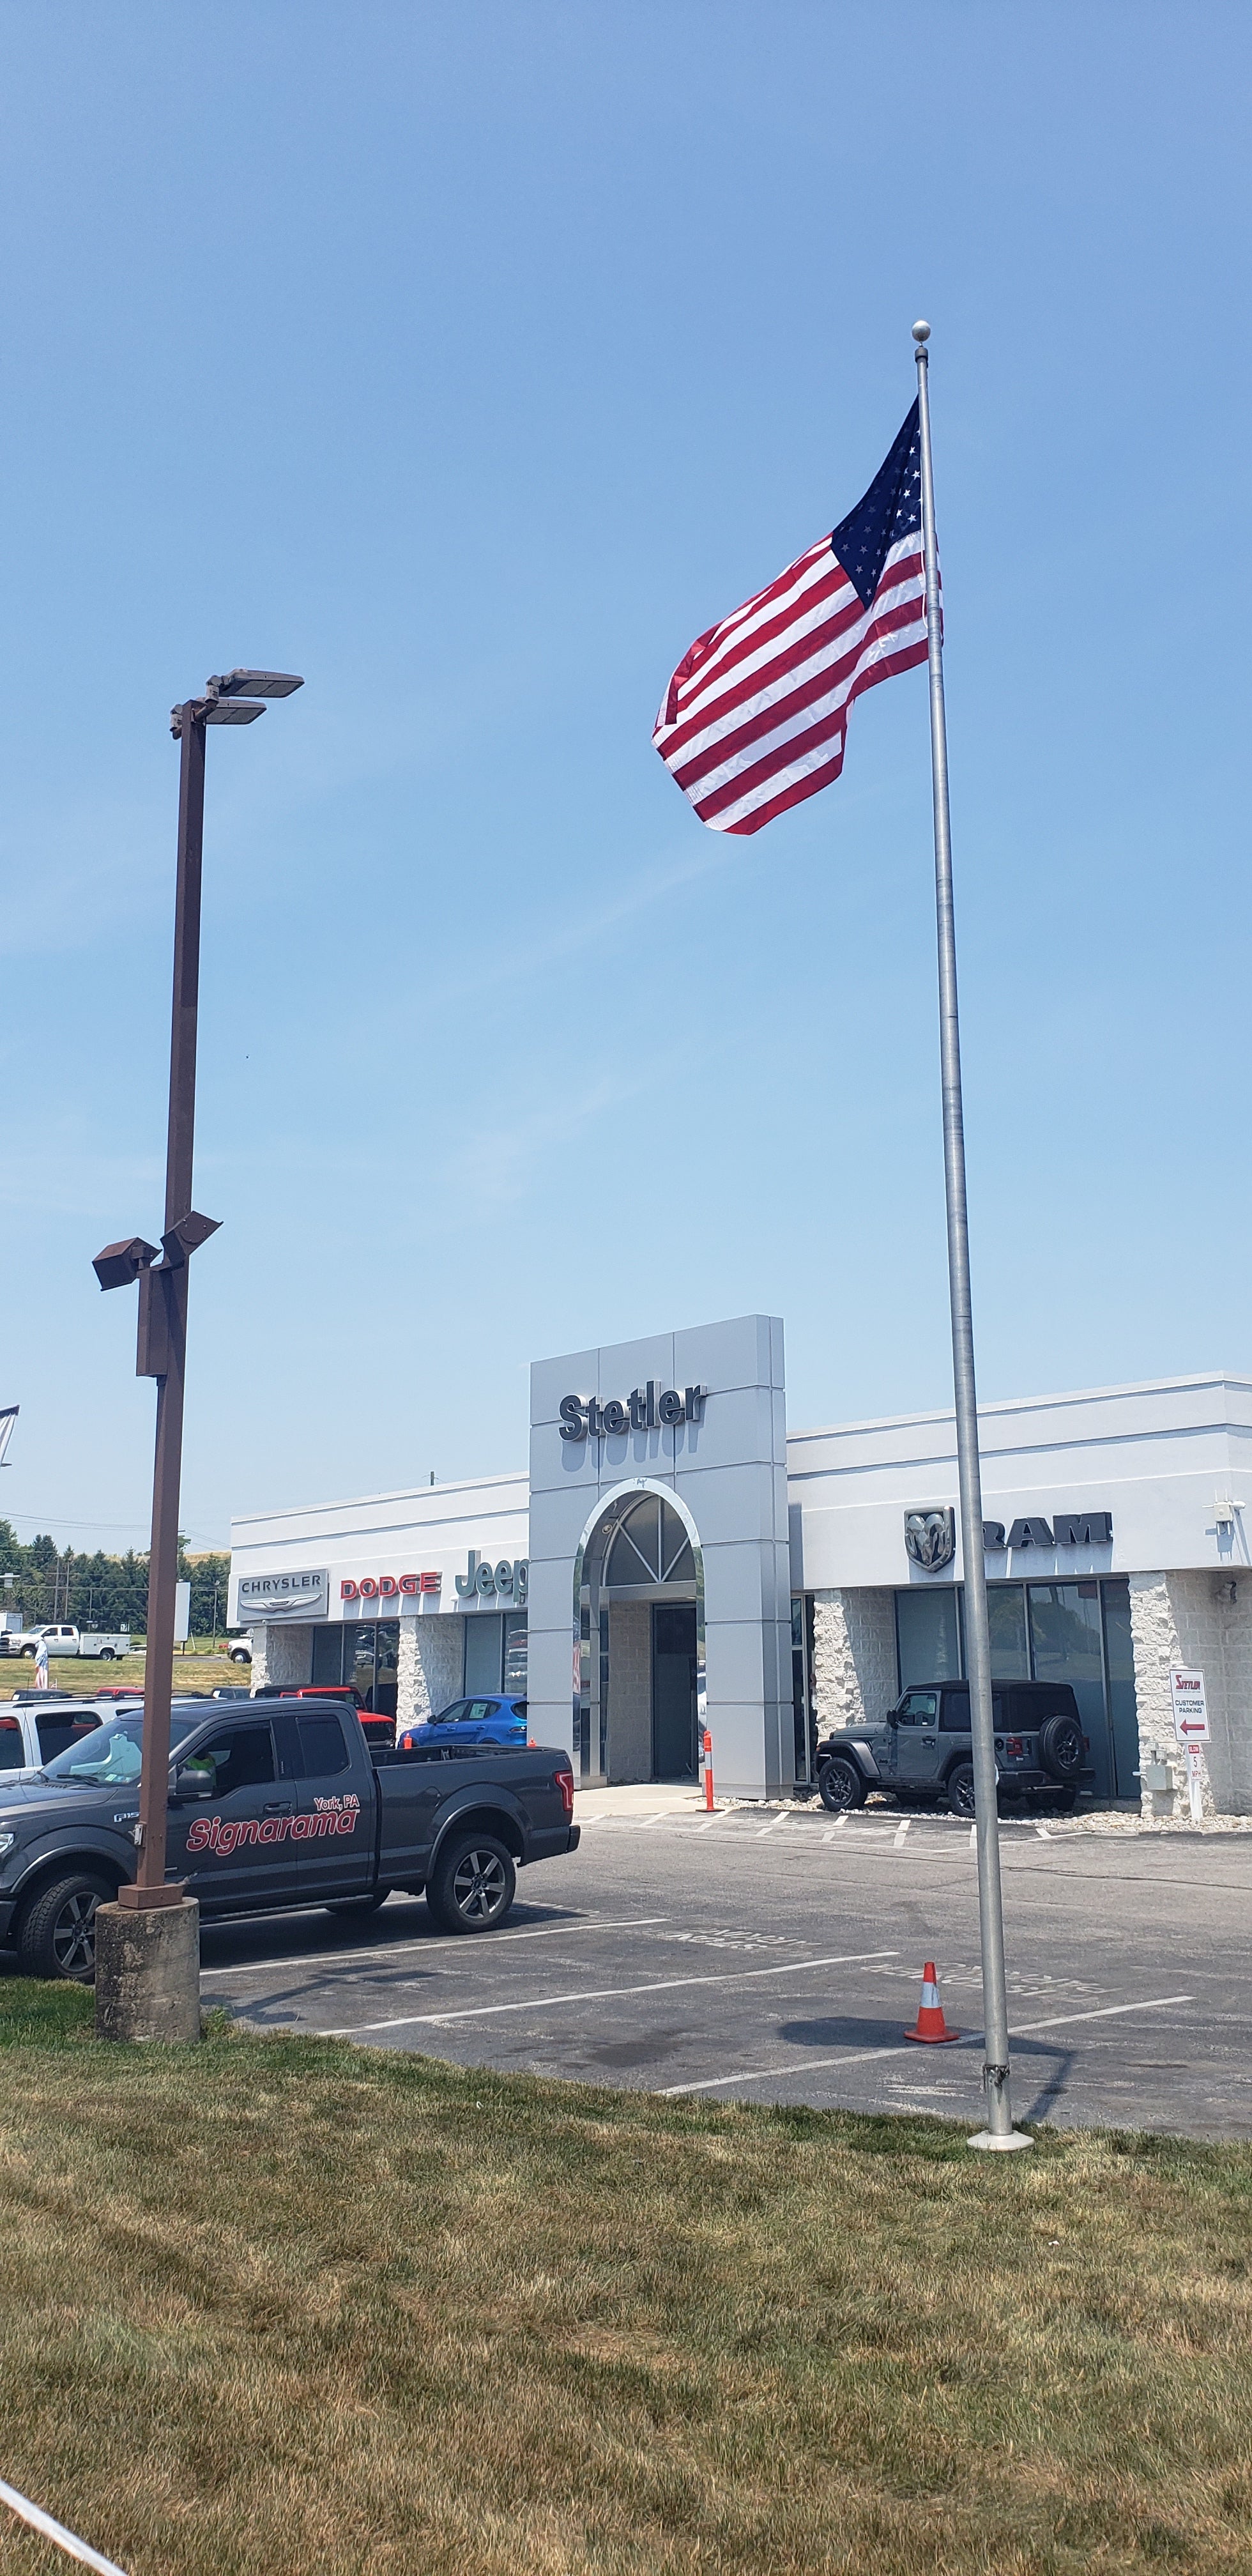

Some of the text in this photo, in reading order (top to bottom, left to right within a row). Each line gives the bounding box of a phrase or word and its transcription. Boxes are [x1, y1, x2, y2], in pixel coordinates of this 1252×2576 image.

[559, 1381, 706, 1441] Stetler
[241, 1575, 321, 1593] CHRYSLER
[340, 1571, 441, 1600] DODGE
[455, 1550, 529, 1602] Jeep
[1193, 1756, 1198, 1768] 5
[314, 1794, 360, 1812] York, PA
[114, 1812, 140, 1822] F15
[186, 1809, 359, 1856] Signarama
